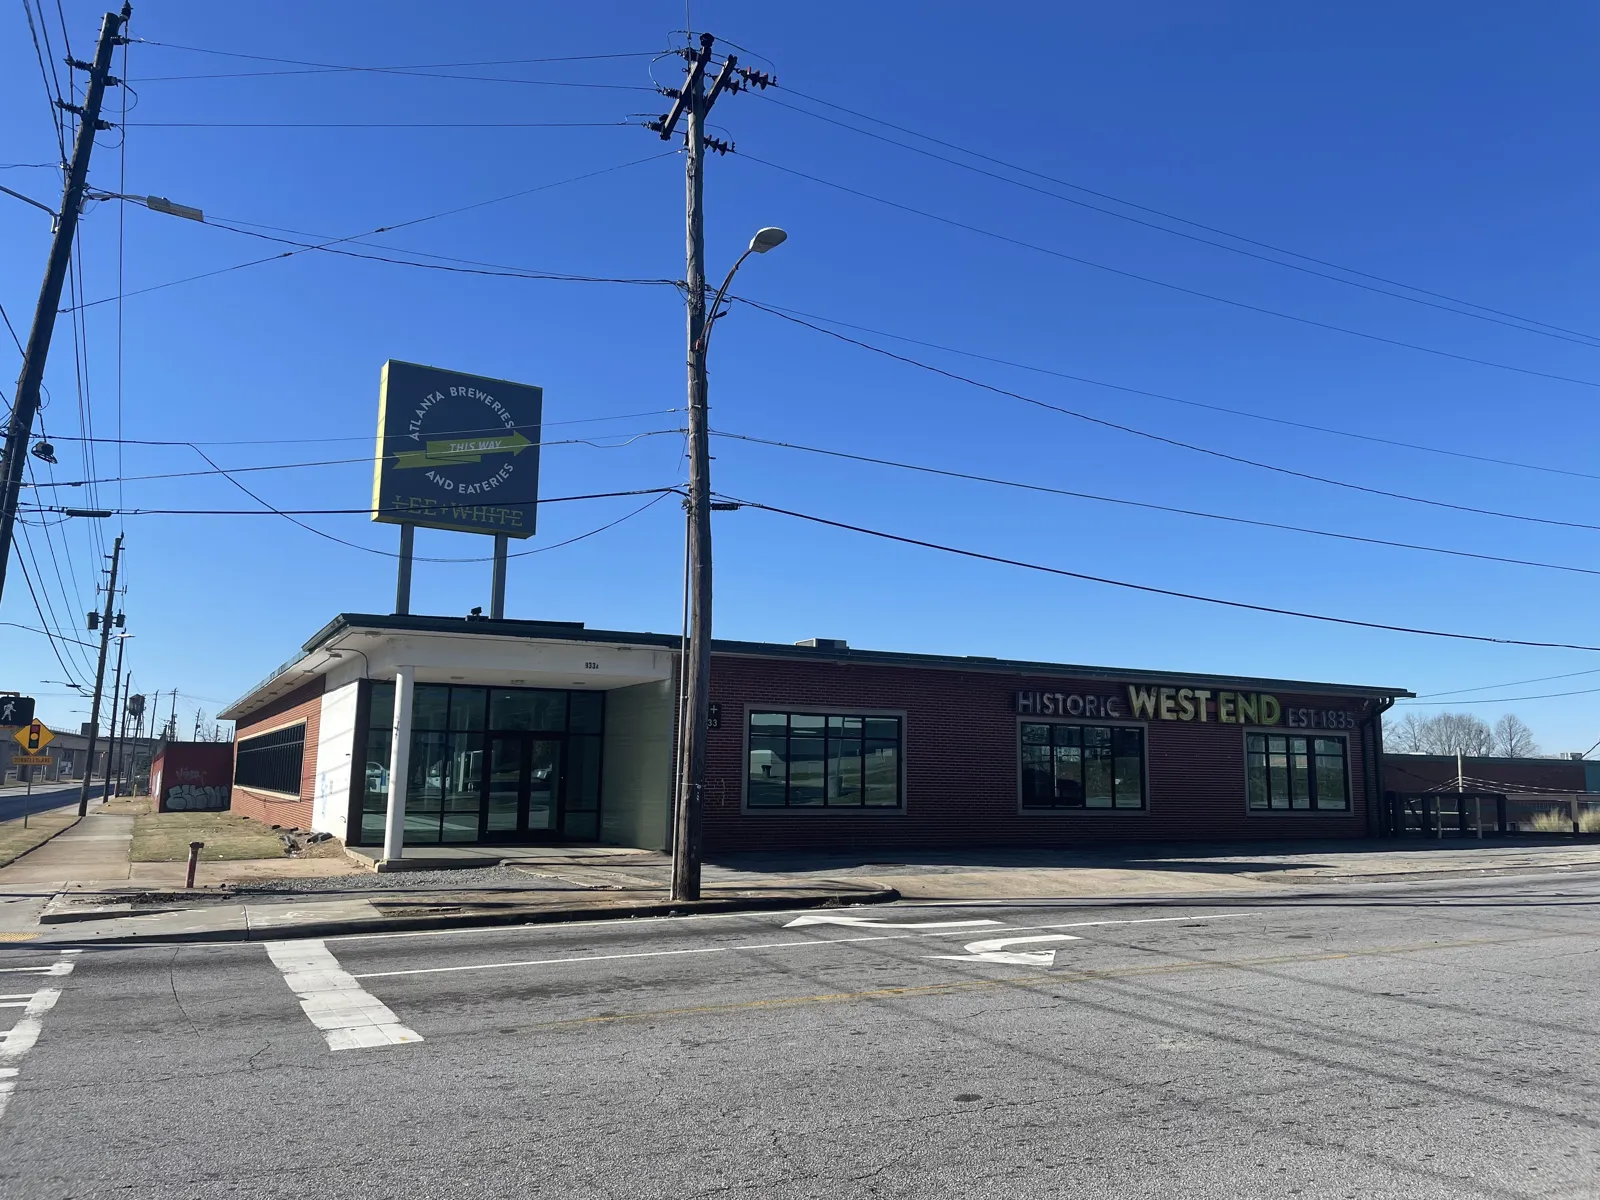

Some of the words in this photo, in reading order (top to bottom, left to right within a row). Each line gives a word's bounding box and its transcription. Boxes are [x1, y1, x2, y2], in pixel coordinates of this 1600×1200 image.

[409, 391, 445, 441] ATLANTA
[450, 386, 515, 429] BREWERIES
[450, 442, 475, 452] THIS
[478, 440, 502, 450] WAY
[425, 470, 454, 490] AND
[458, 462, 514, 494] EATERIES
[1017, 691, 1121, 717] HISTORIC
[1127, 684, 1212, 722] WEST
[1218, 691, 1281, 725] END
[1287, 707, 1316, 728] EST
[1321, 710, 1355, 729] 1835
